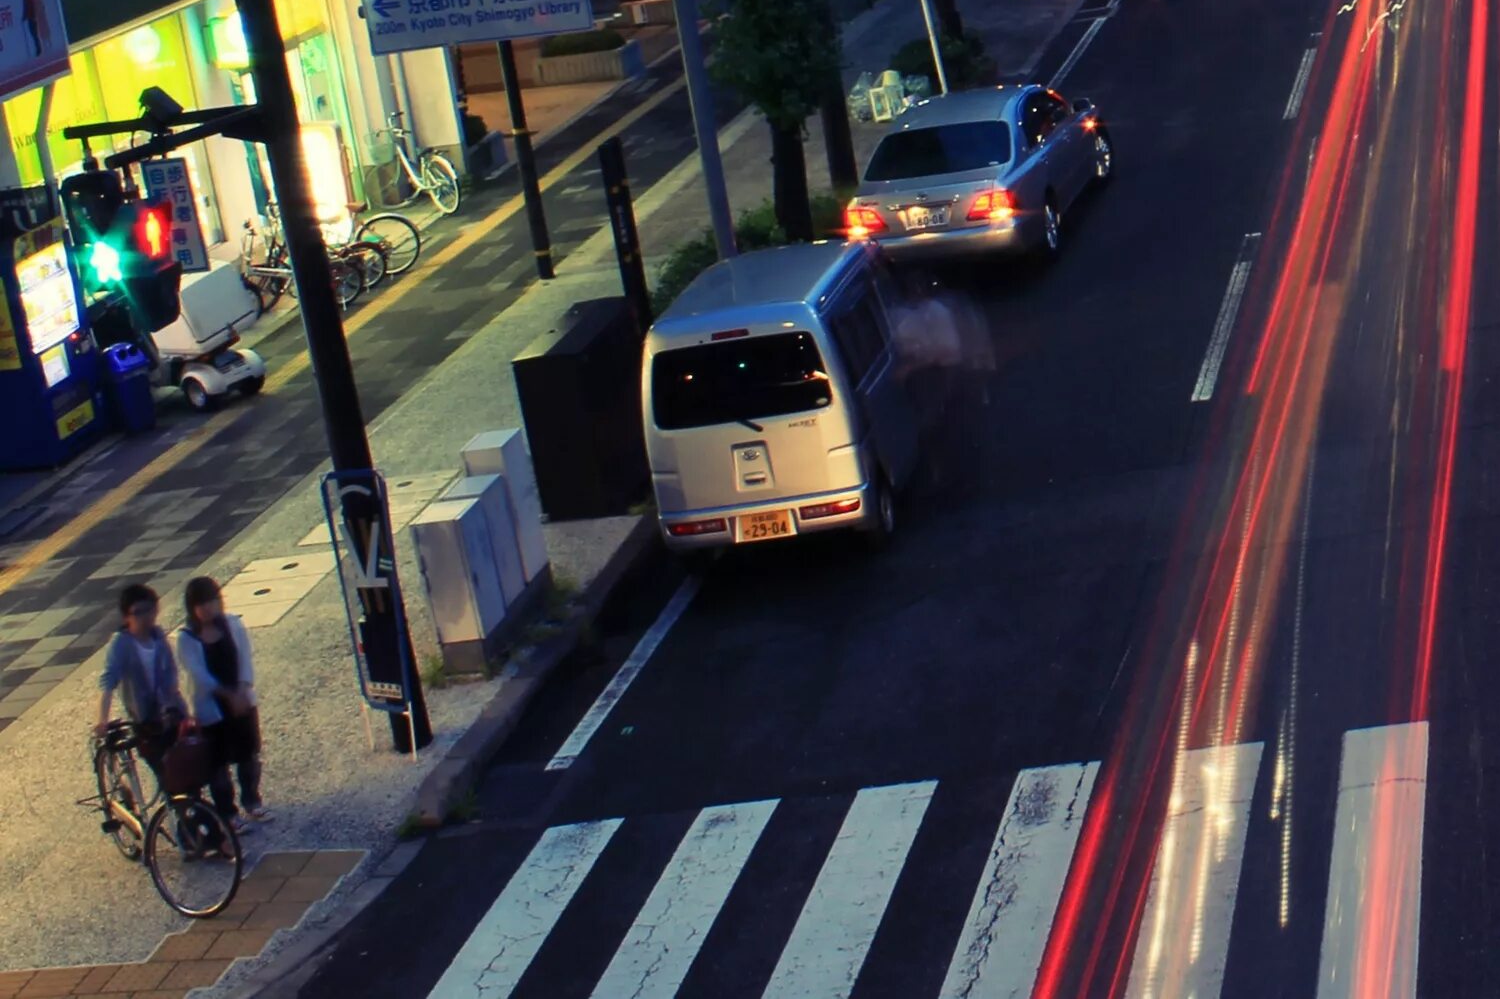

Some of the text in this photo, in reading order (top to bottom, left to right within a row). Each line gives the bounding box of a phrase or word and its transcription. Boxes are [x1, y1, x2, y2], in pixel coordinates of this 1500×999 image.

[375, 0, 581, 36] 200m Kyoto City Shimogyo Library
